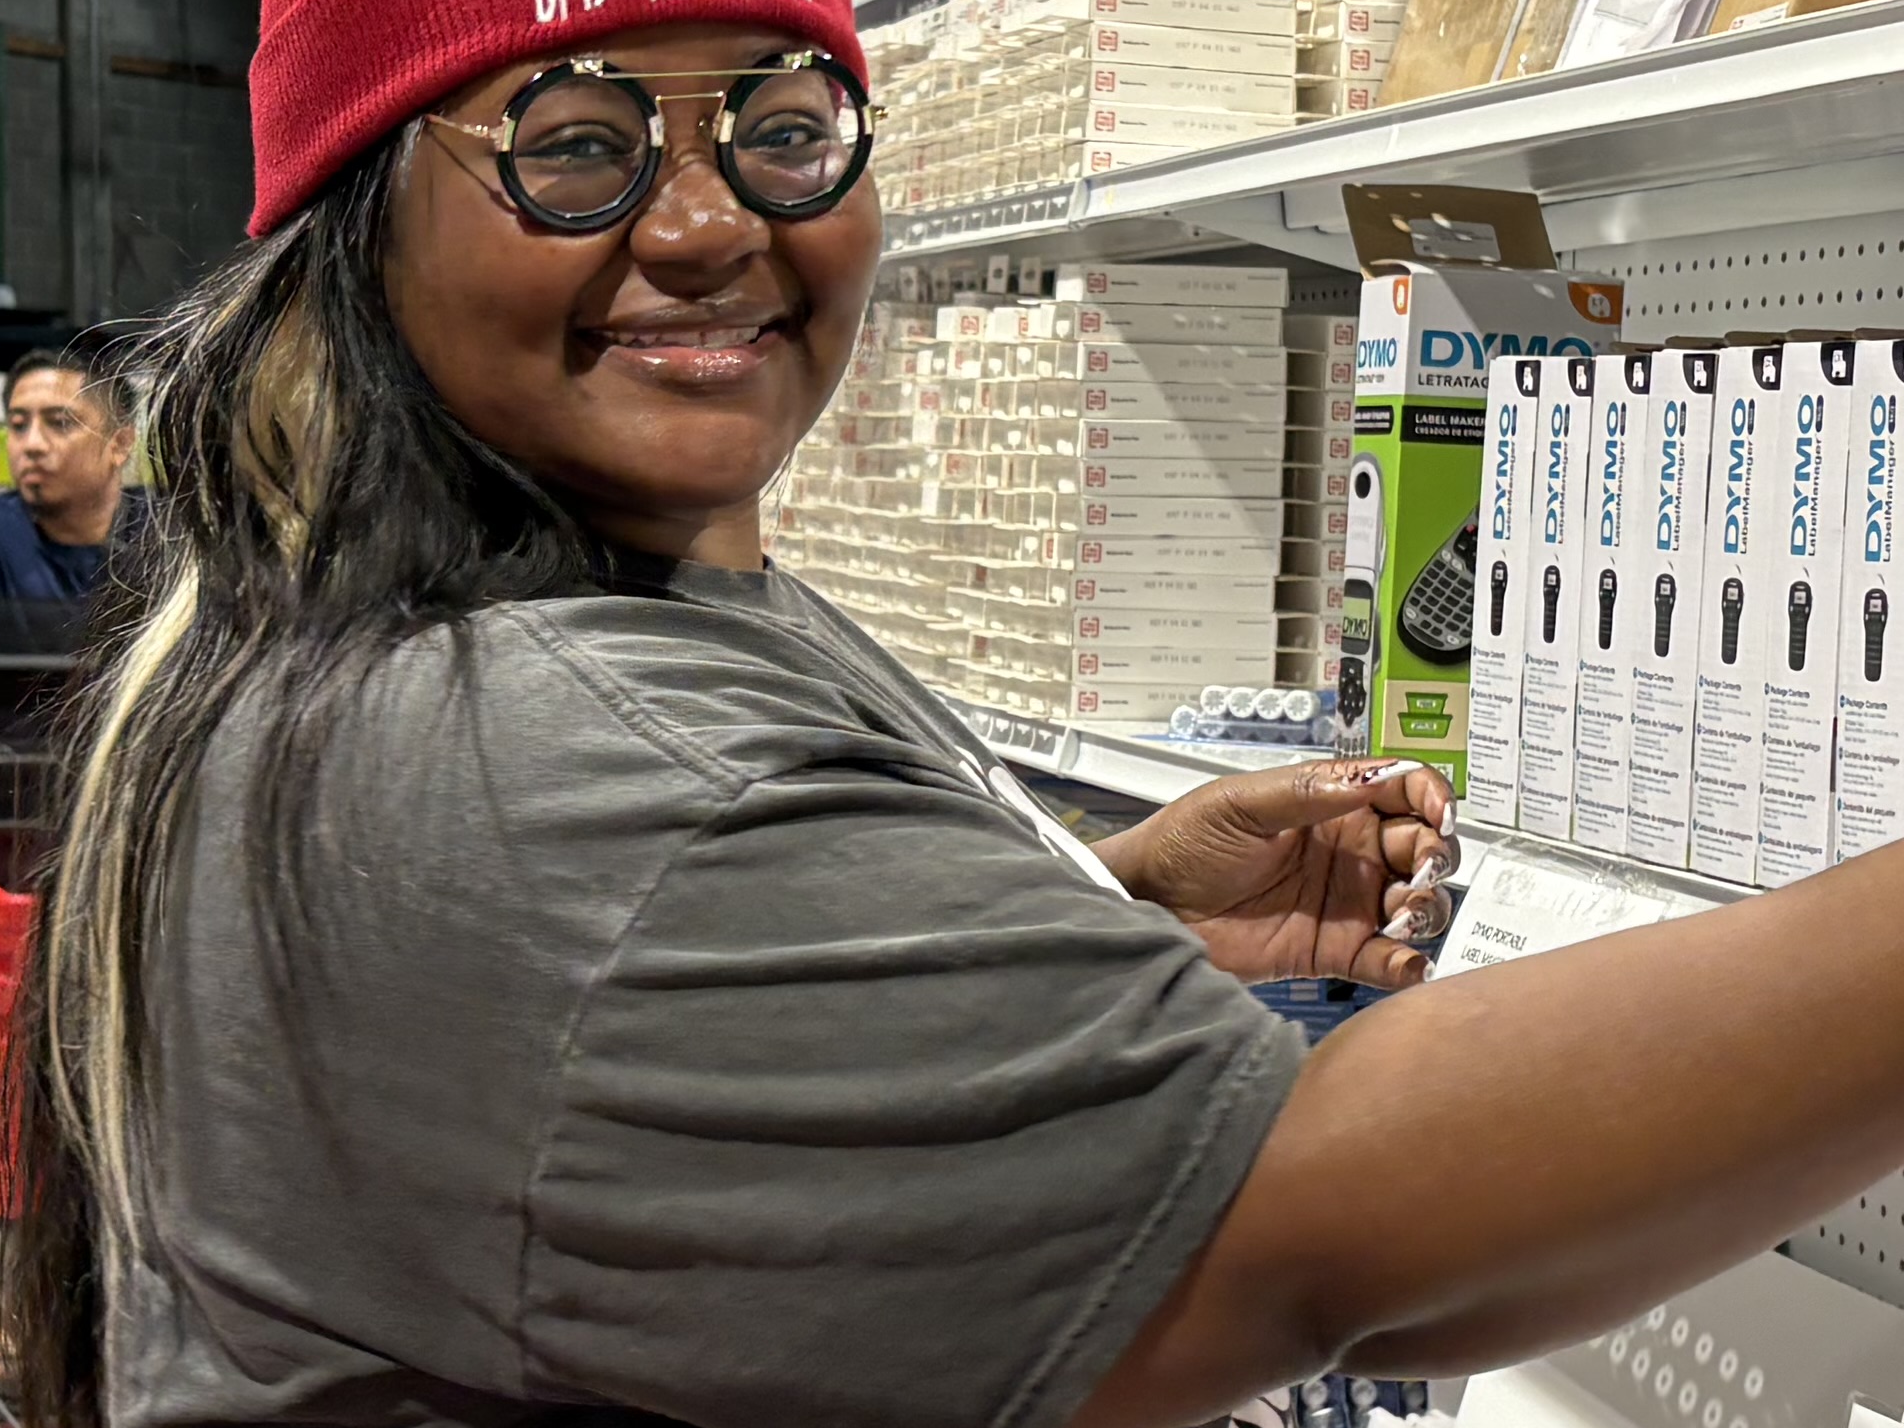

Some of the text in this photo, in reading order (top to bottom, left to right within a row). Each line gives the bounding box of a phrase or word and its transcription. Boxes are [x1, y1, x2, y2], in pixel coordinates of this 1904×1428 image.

[1358, 337, 1397, 368] DYMO
[1420, 329, 1593, 370] DYMO
[1494, 404, 1510, 539] DYMO
[1545, 403, 1562, 544] DYMO
[1601, 401, 1618, 546] DYMO
[1657, 400, 1677, 550] DYMO
[1724, 398, 1745, 553] DYMO
[1791, 394, 1814, 556] DYMO
[1865, 395, 1887, 562] DYMO
